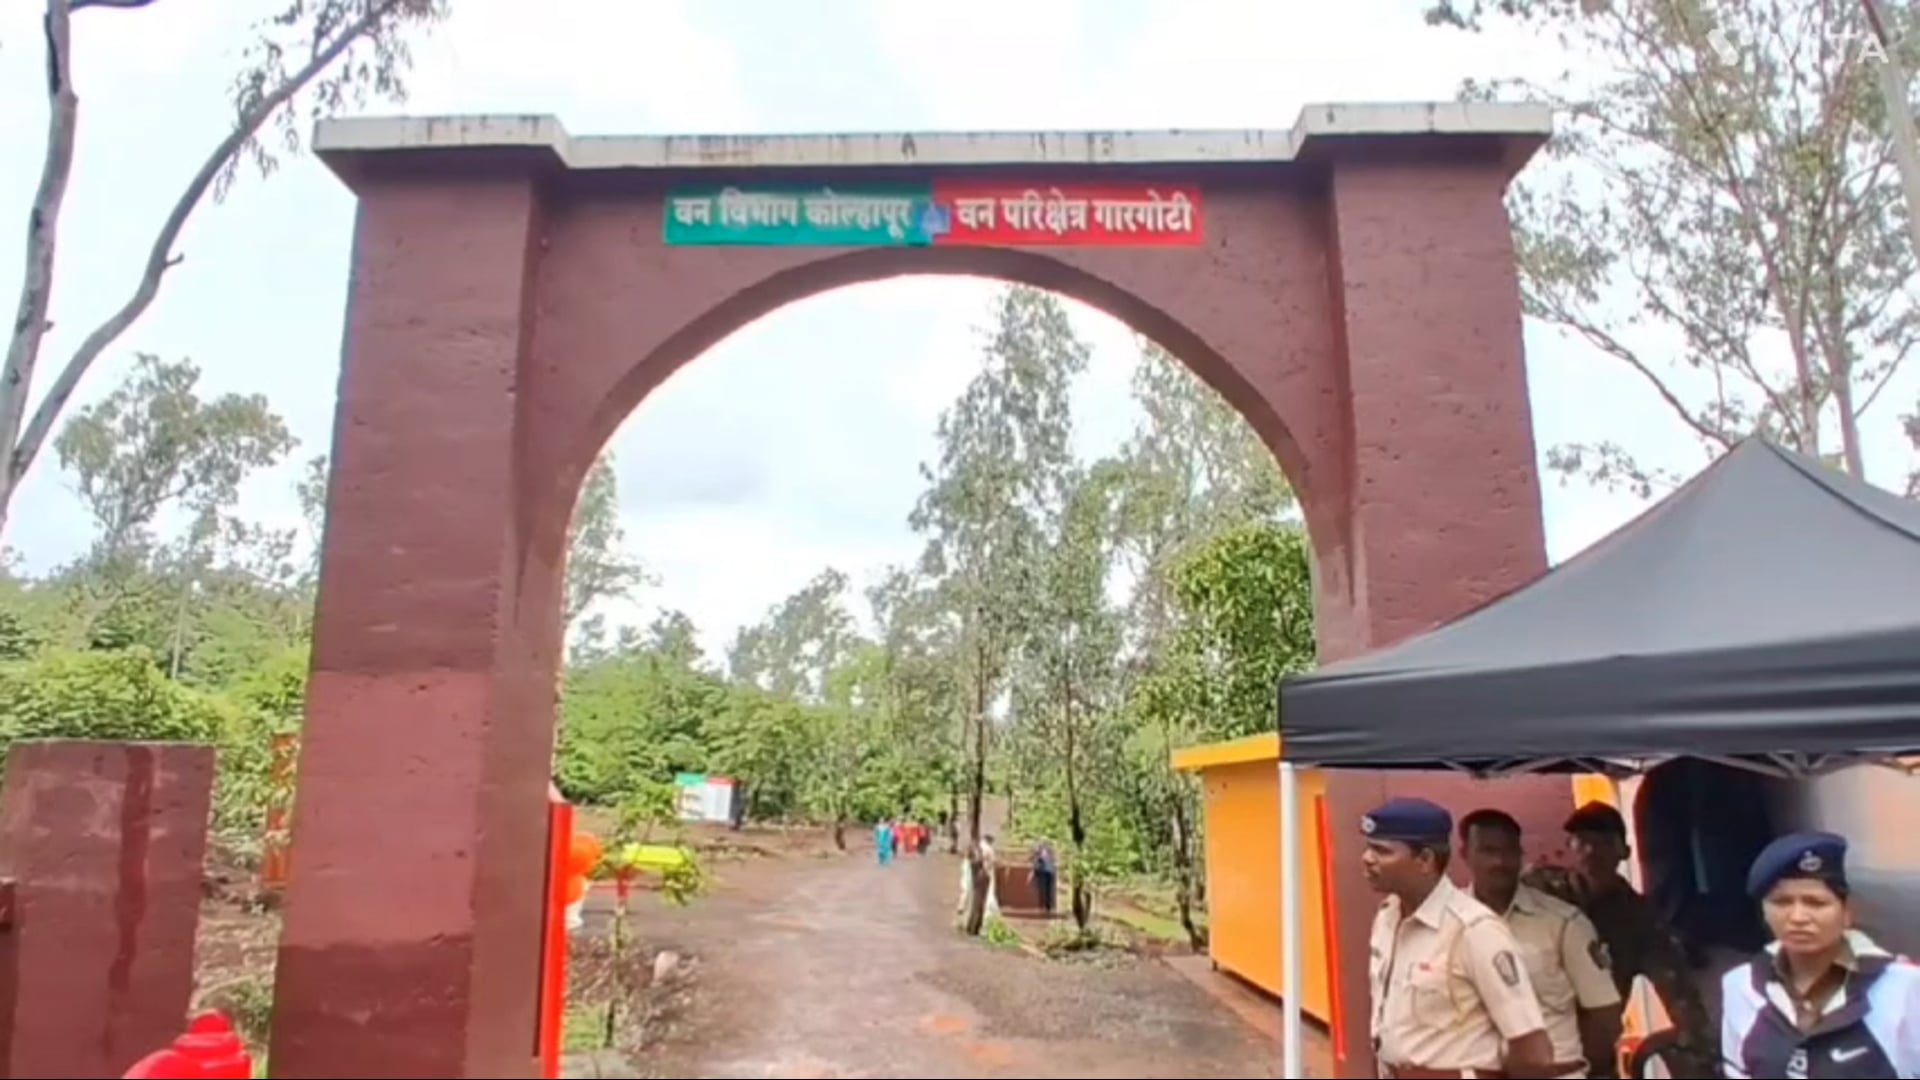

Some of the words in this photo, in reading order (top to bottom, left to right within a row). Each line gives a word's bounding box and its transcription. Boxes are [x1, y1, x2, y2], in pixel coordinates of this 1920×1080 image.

[673, 196, 712, 226] वन
[718, 187, 798, 227] विभाग
[804, 188, 913, 239] कोल्हापूर
[955, 197, 996, 230] वन
[1001, 187, 1088, 235] परिक्षेत्र
[1093, 189, 1193, 233] गारगोटी
